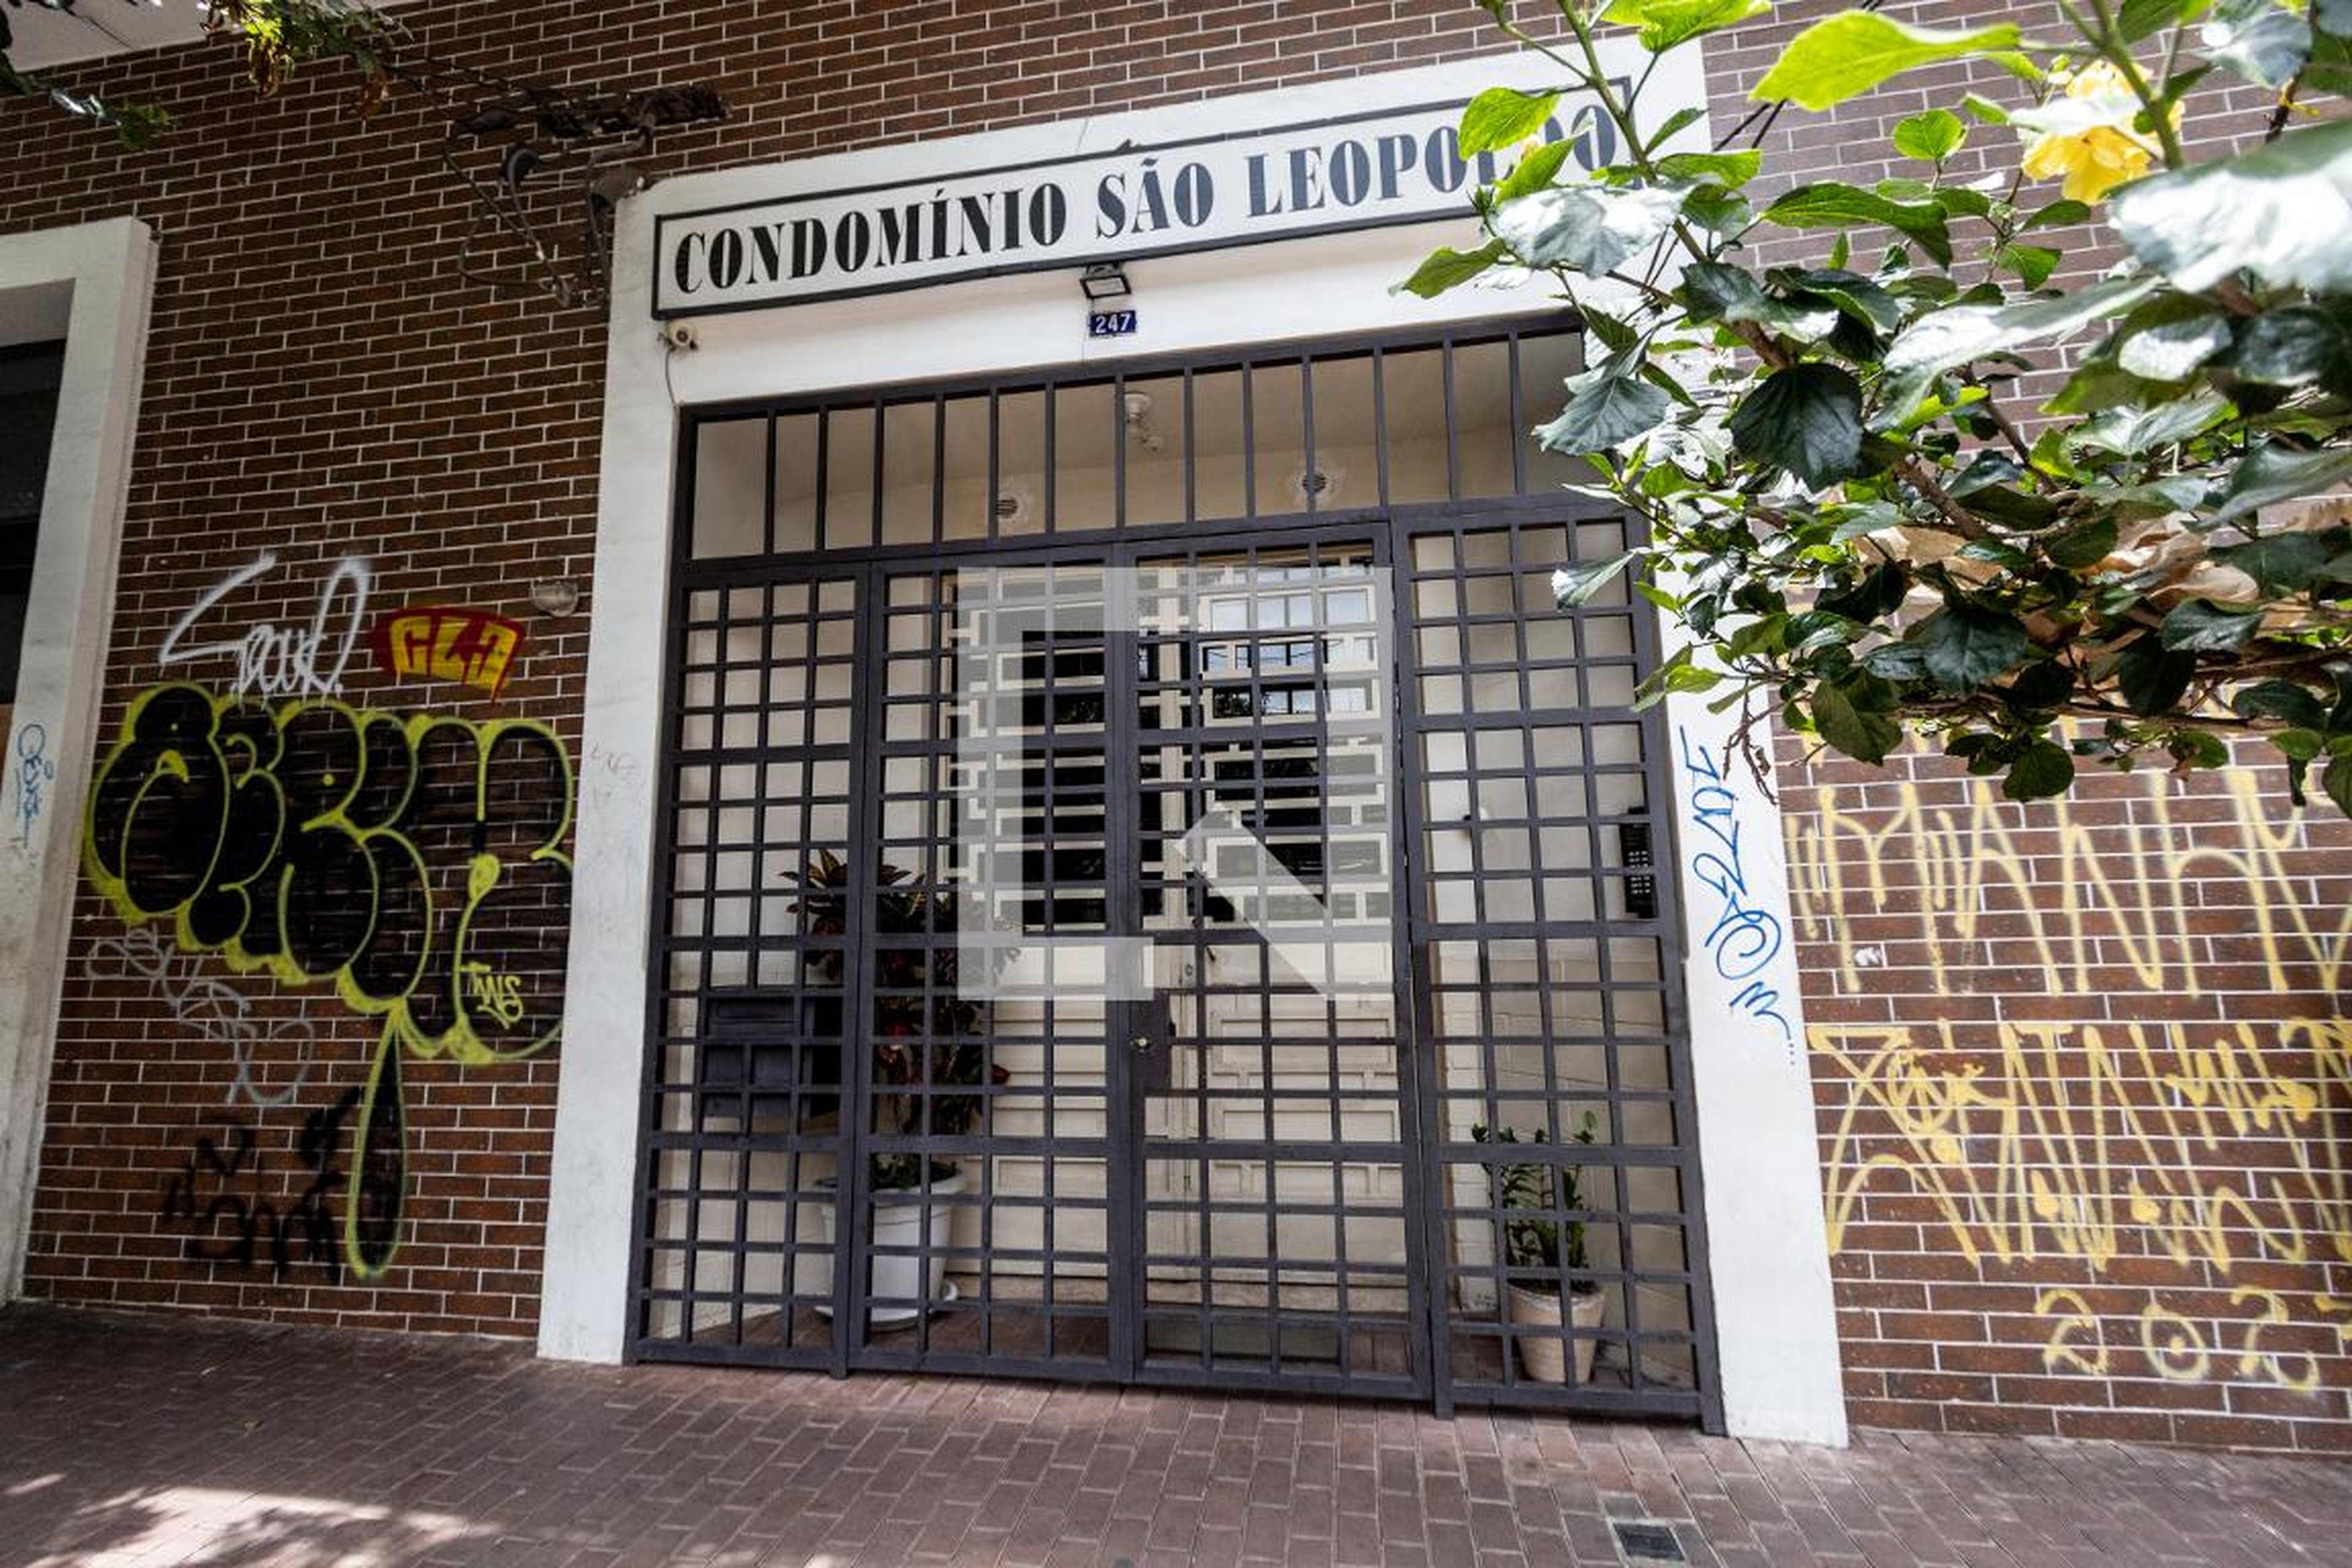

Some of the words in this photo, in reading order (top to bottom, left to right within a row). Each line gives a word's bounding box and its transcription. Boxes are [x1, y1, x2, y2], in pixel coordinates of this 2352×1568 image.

[674, 182, 1068, 294] CONDOMÍNIO
[1096, 156, 1215, 241] SÃO
[1245, 105, 1616, 218] LEOPOO
[1095, 313, 1131, 333] 247
